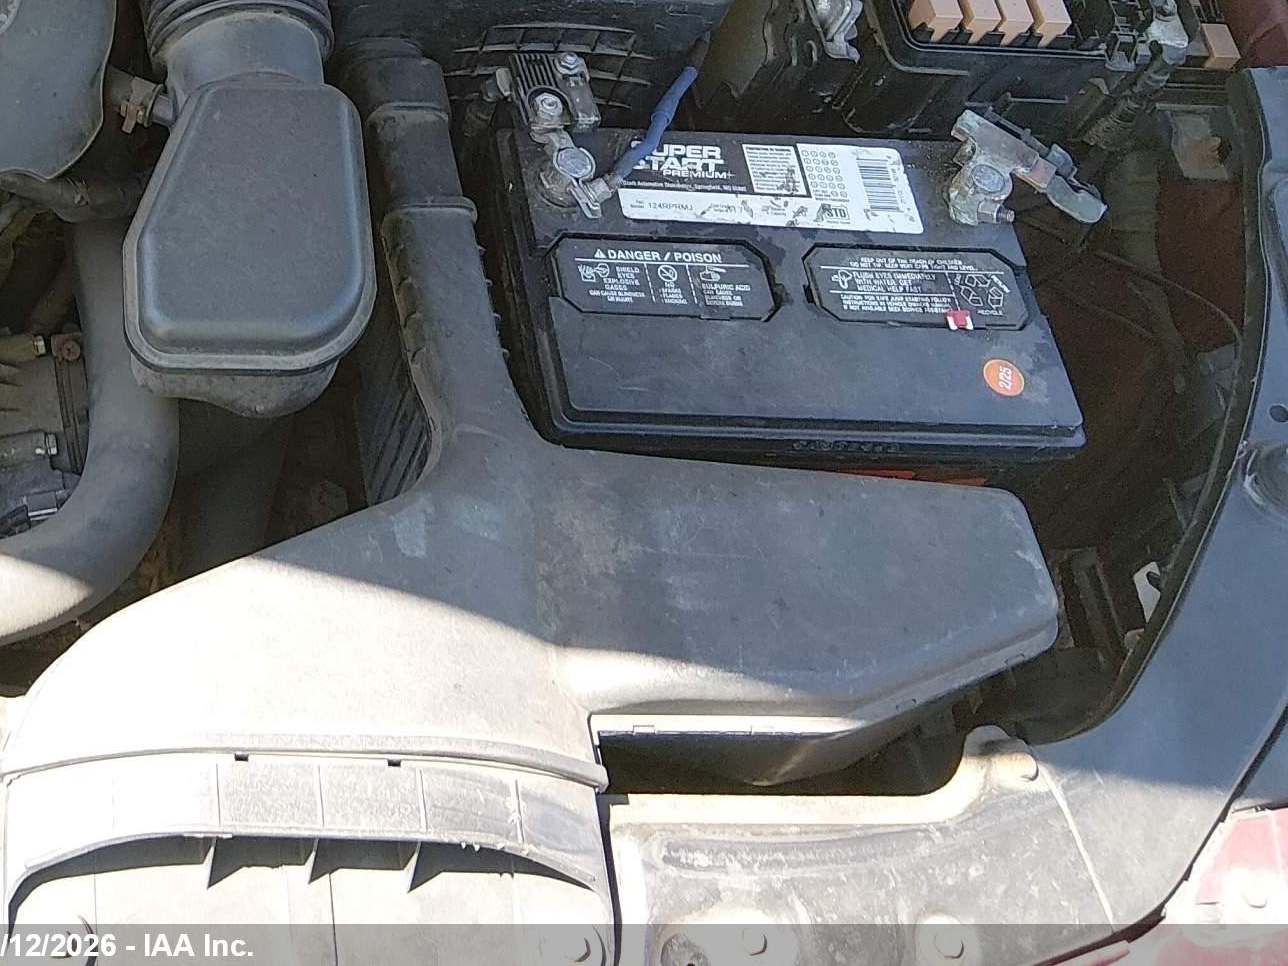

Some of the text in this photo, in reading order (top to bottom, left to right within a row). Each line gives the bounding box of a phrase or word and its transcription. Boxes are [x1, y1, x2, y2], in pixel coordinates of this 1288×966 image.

[631, 140, 721, 159] UPER
[608, 249, 661, 261] DANGER
[674, 252, 722, 263] POISON
[998, 366, 1013, 390] 2/25
